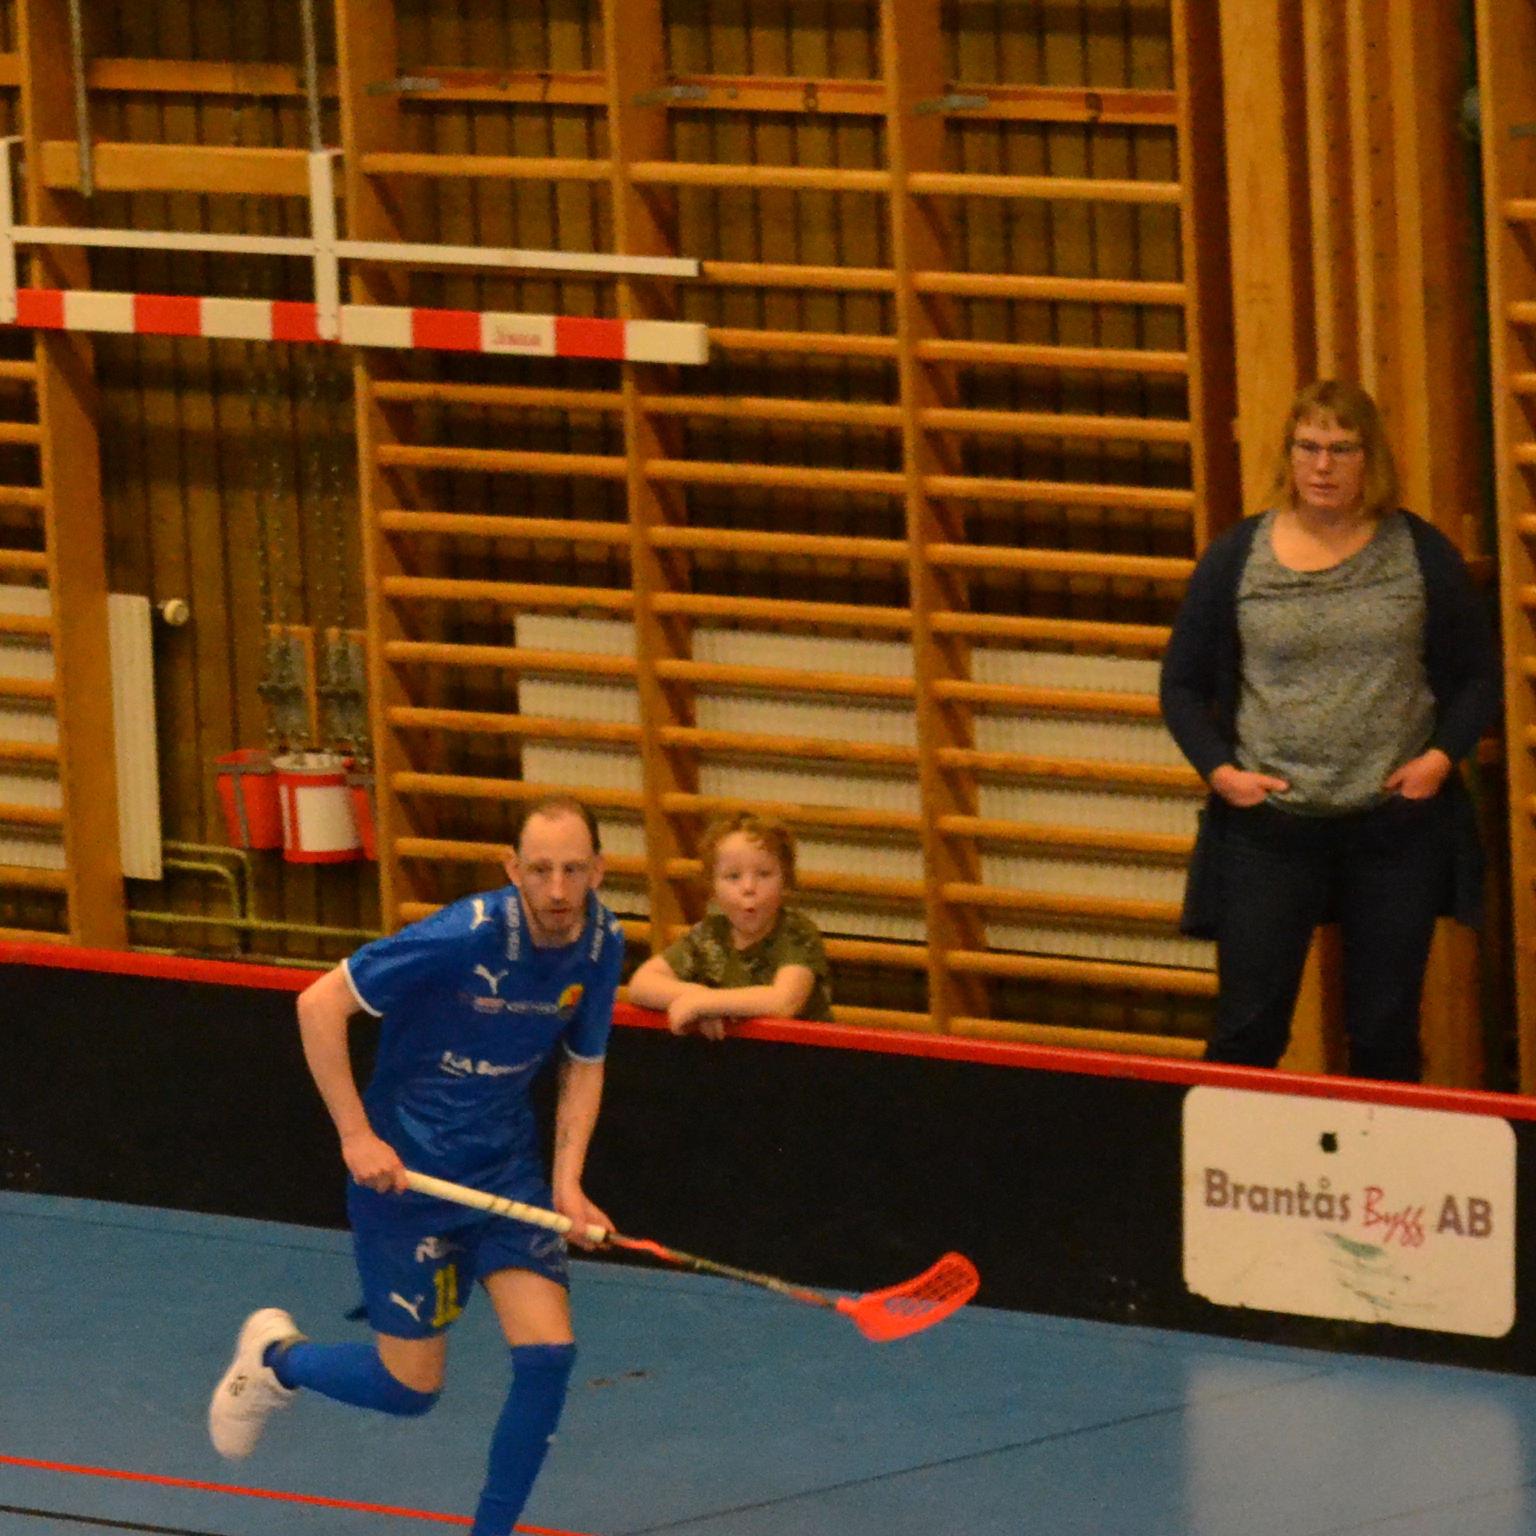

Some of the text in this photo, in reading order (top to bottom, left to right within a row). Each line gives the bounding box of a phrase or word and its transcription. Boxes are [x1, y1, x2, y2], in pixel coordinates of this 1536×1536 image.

[1204, 1167, 1494, 1249] Brantås Bygg AB
